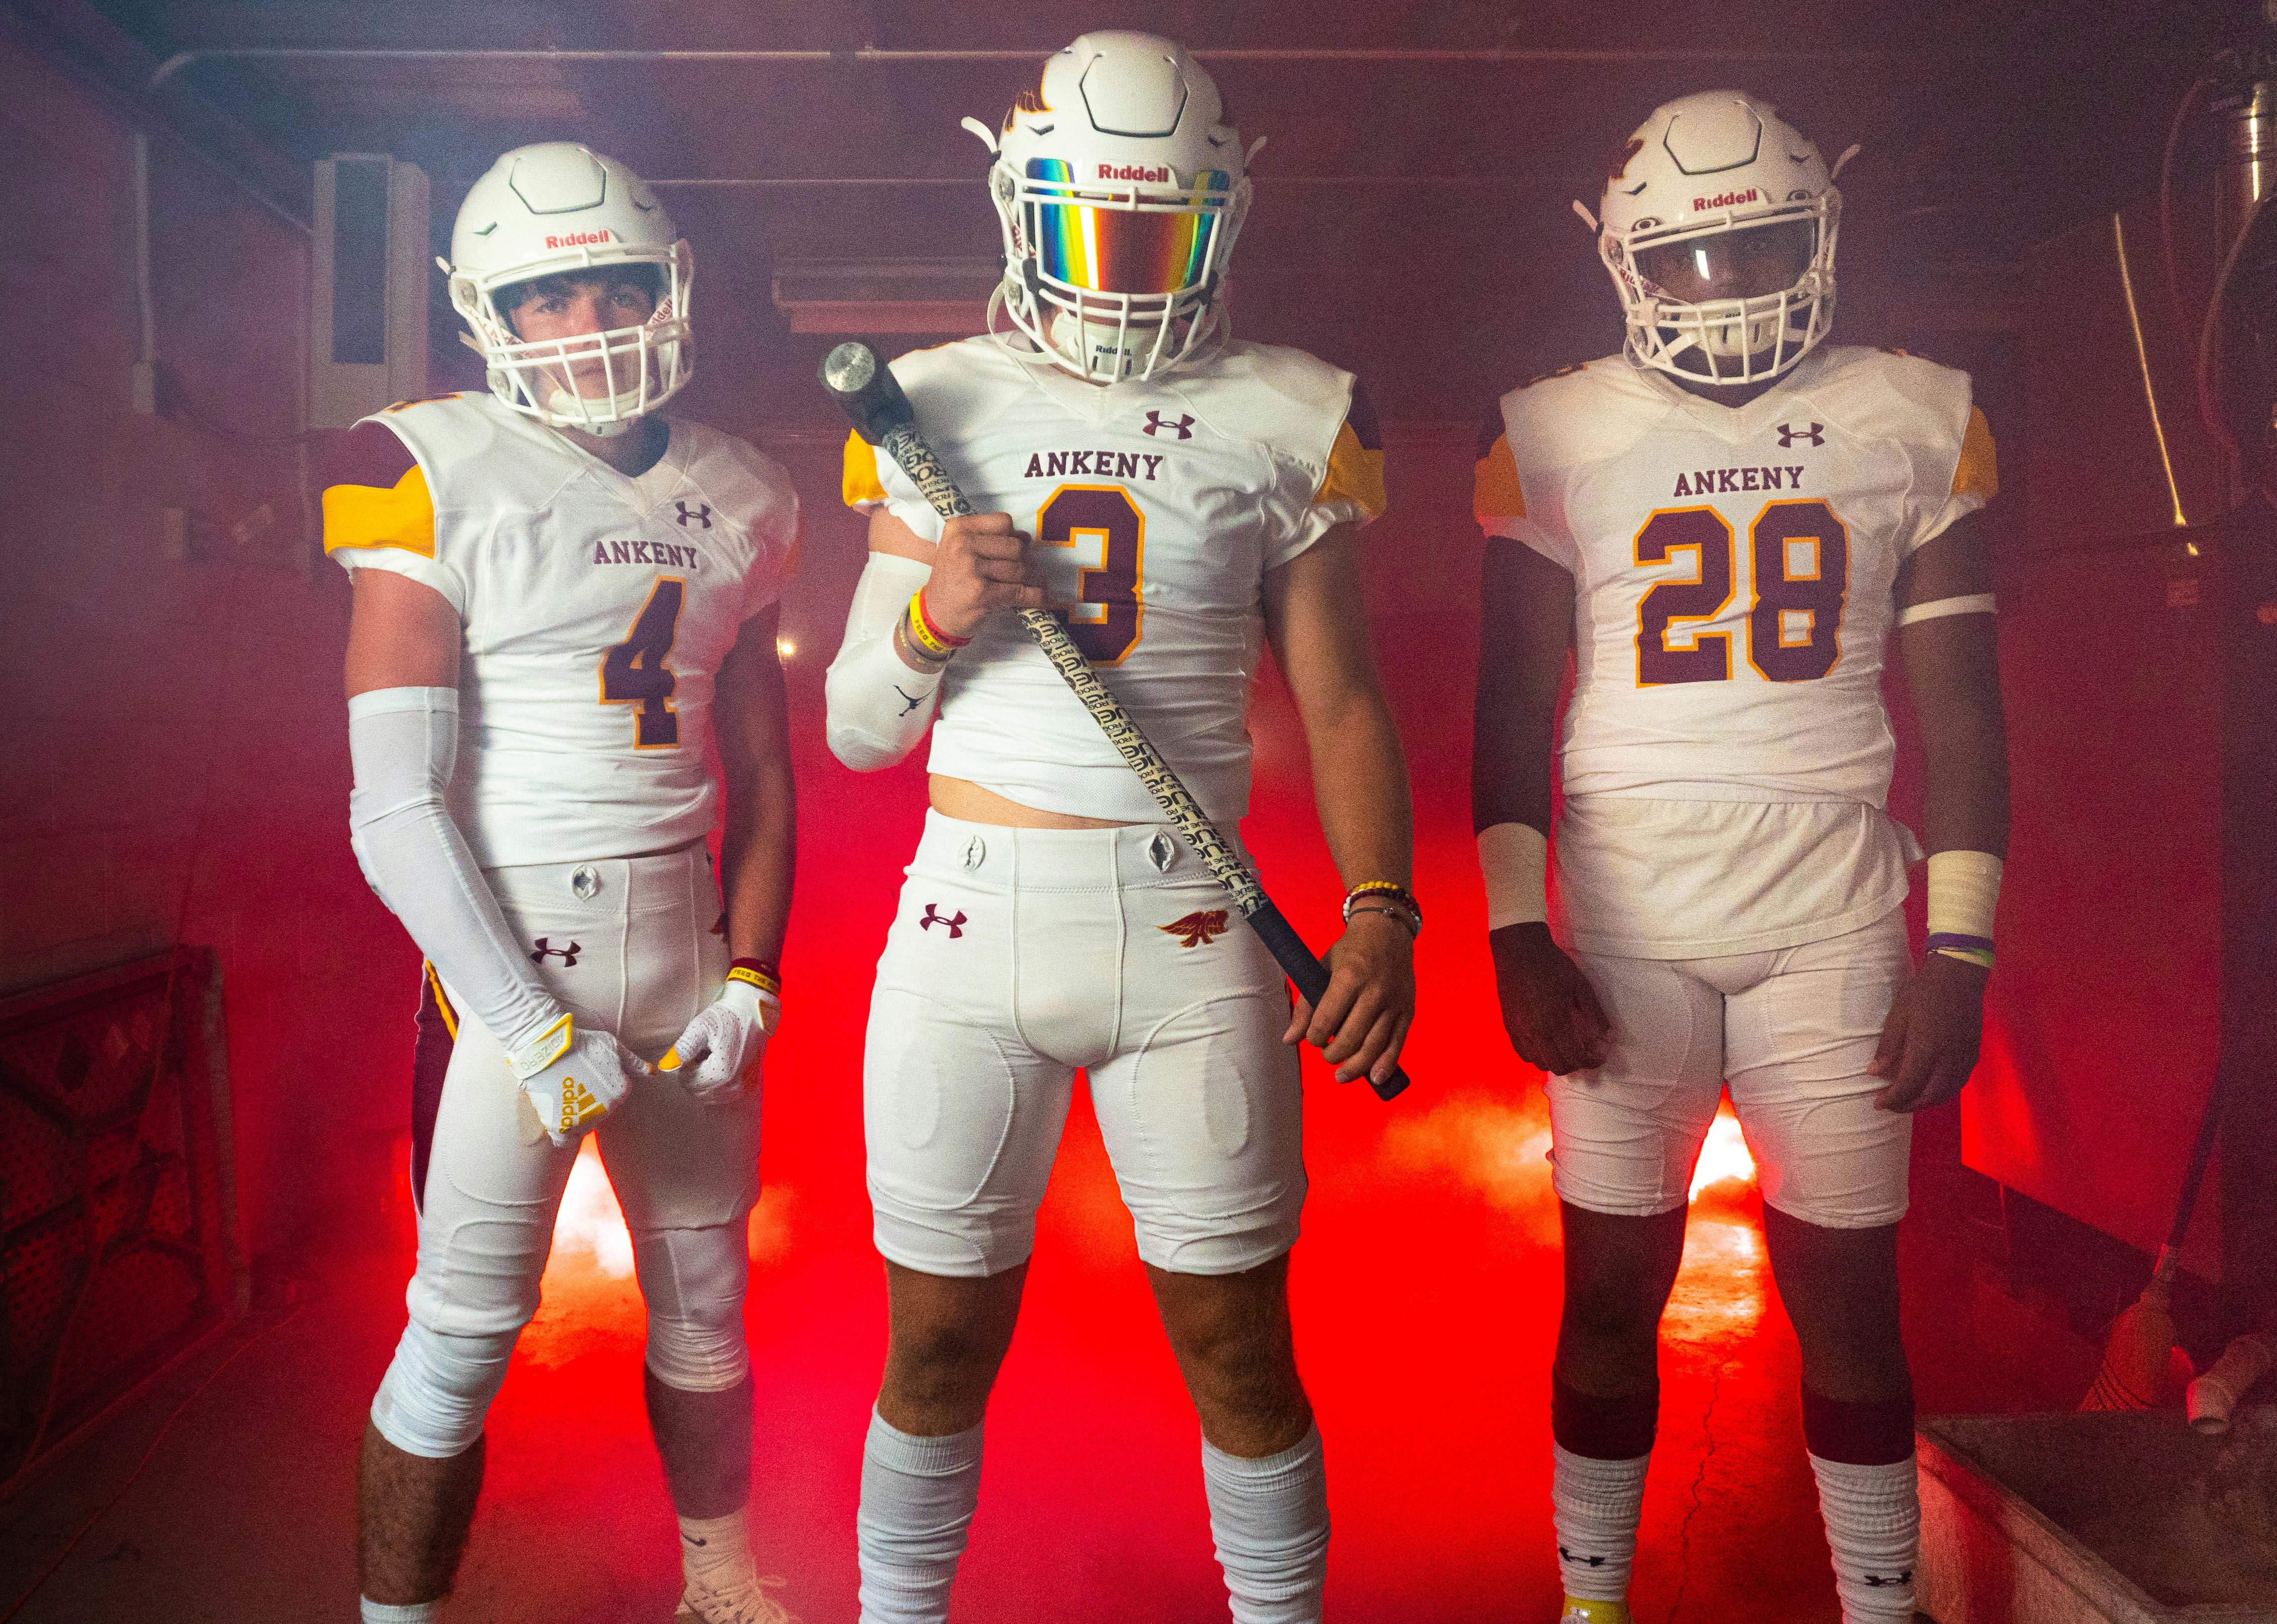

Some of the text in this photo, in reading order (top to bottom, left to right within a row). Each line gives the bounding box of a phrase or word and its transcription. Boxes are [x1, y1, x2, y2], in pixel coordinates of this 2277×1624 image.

[1098, 164, 1169, 183] Riddell
[1693, 188, 1757, 211] Riddell
[545, 229, 610, 249] Riddell
[1096, 345, 1130, 356] Riddll
[1024, 450, 1163, 480] ANKENY
[1674, 466, 1804, 497] ANKENY
[593, 541, 697, 569] ANKENY
[1036, 483, 1146, 667] 3
[1633, 497, 1851, 689] 28
[914, 619, 929, 640] FEED
[598, 575, 687, 750] 4
[733, 968, 751, 978] FEED
[520, 1030, 564, 1071] ADIZERO
